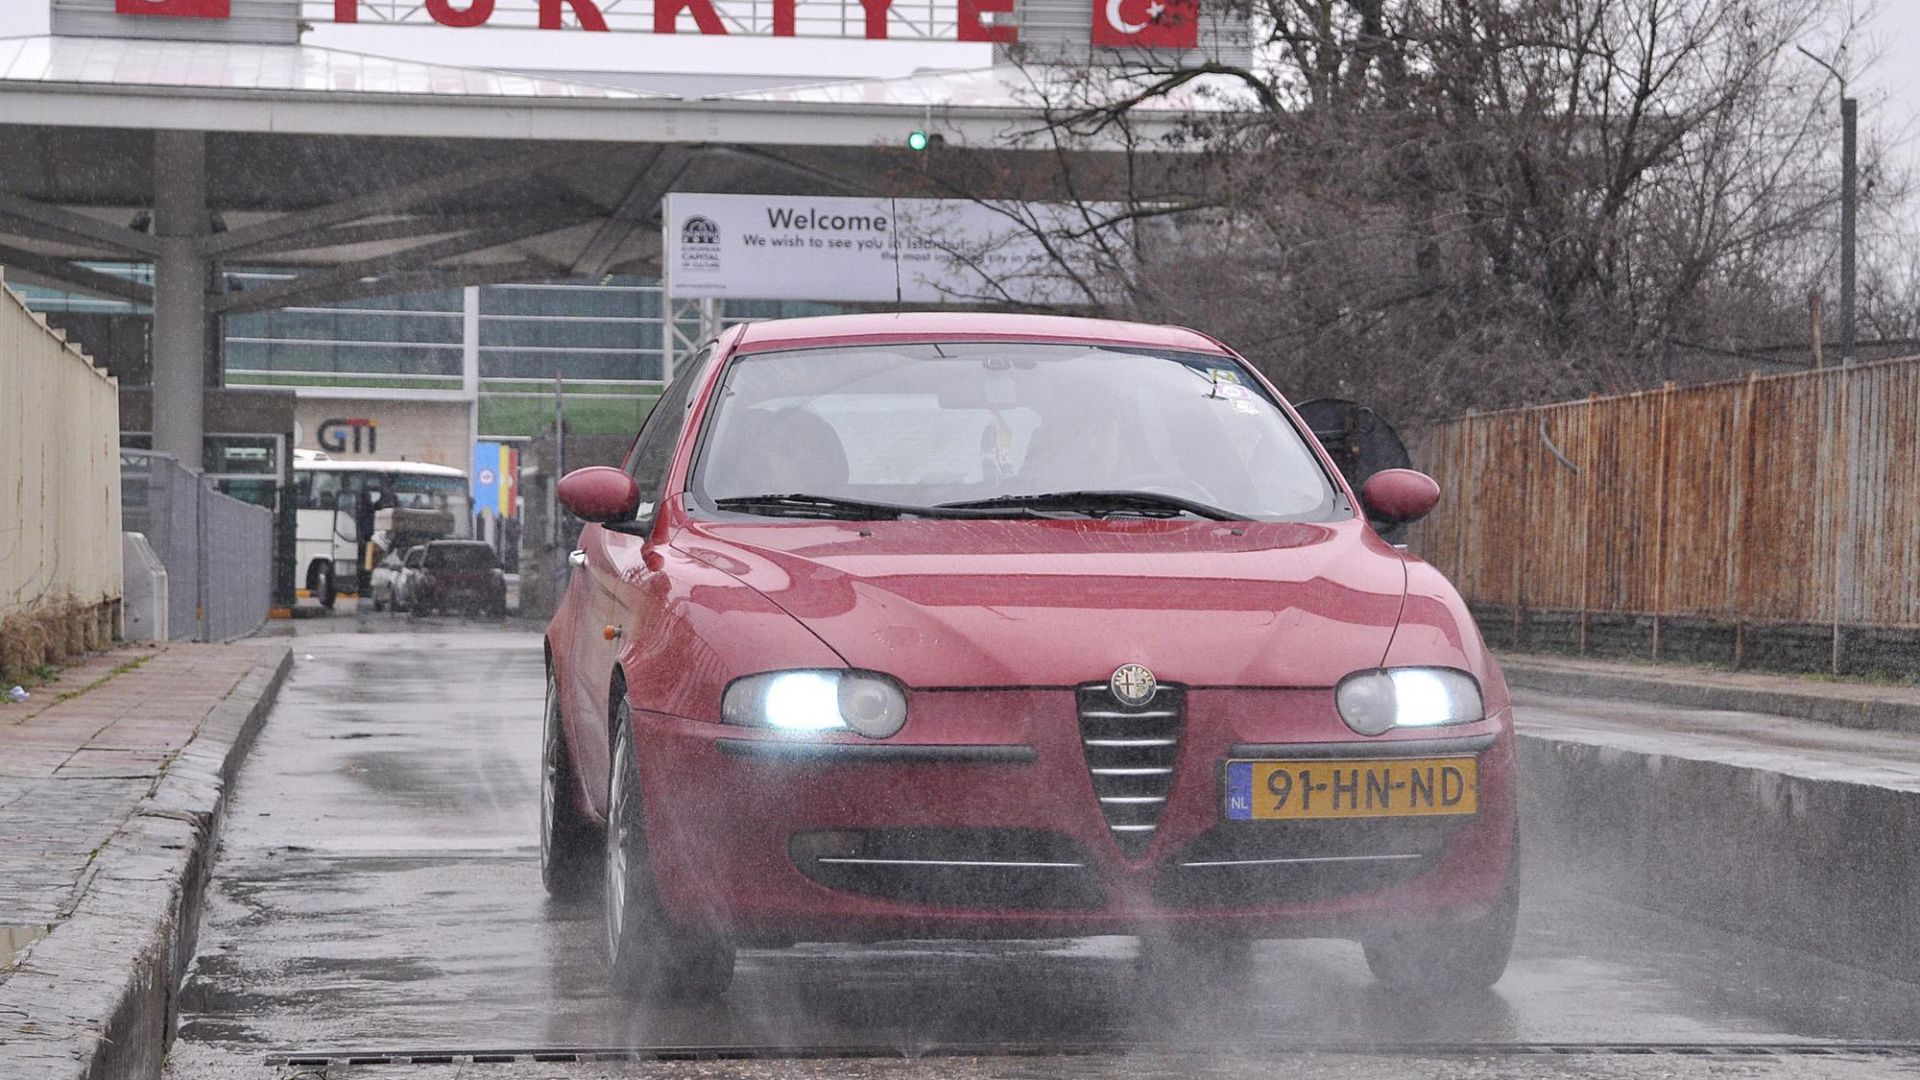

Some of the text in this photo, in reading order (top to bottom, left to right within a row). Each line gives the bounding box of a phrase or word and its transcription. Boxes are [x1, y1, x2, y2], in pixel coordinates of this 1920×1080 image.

[767, 207, 887, 231] Welcome
[743, 234, 766, 247] We
[771, 234, 804, 247] wish
[809, 235, 822, 248] to
[828, 238, 852, 248] see
[857, 237, 883, 251] you
[317, 418, 378, 453] GTI
[1115, 666, 1153, 687] ALFA ROMEO
[1267, 766, 1464, 811] 91-HN-ND
[1231, 797, 1248, 810] NL
